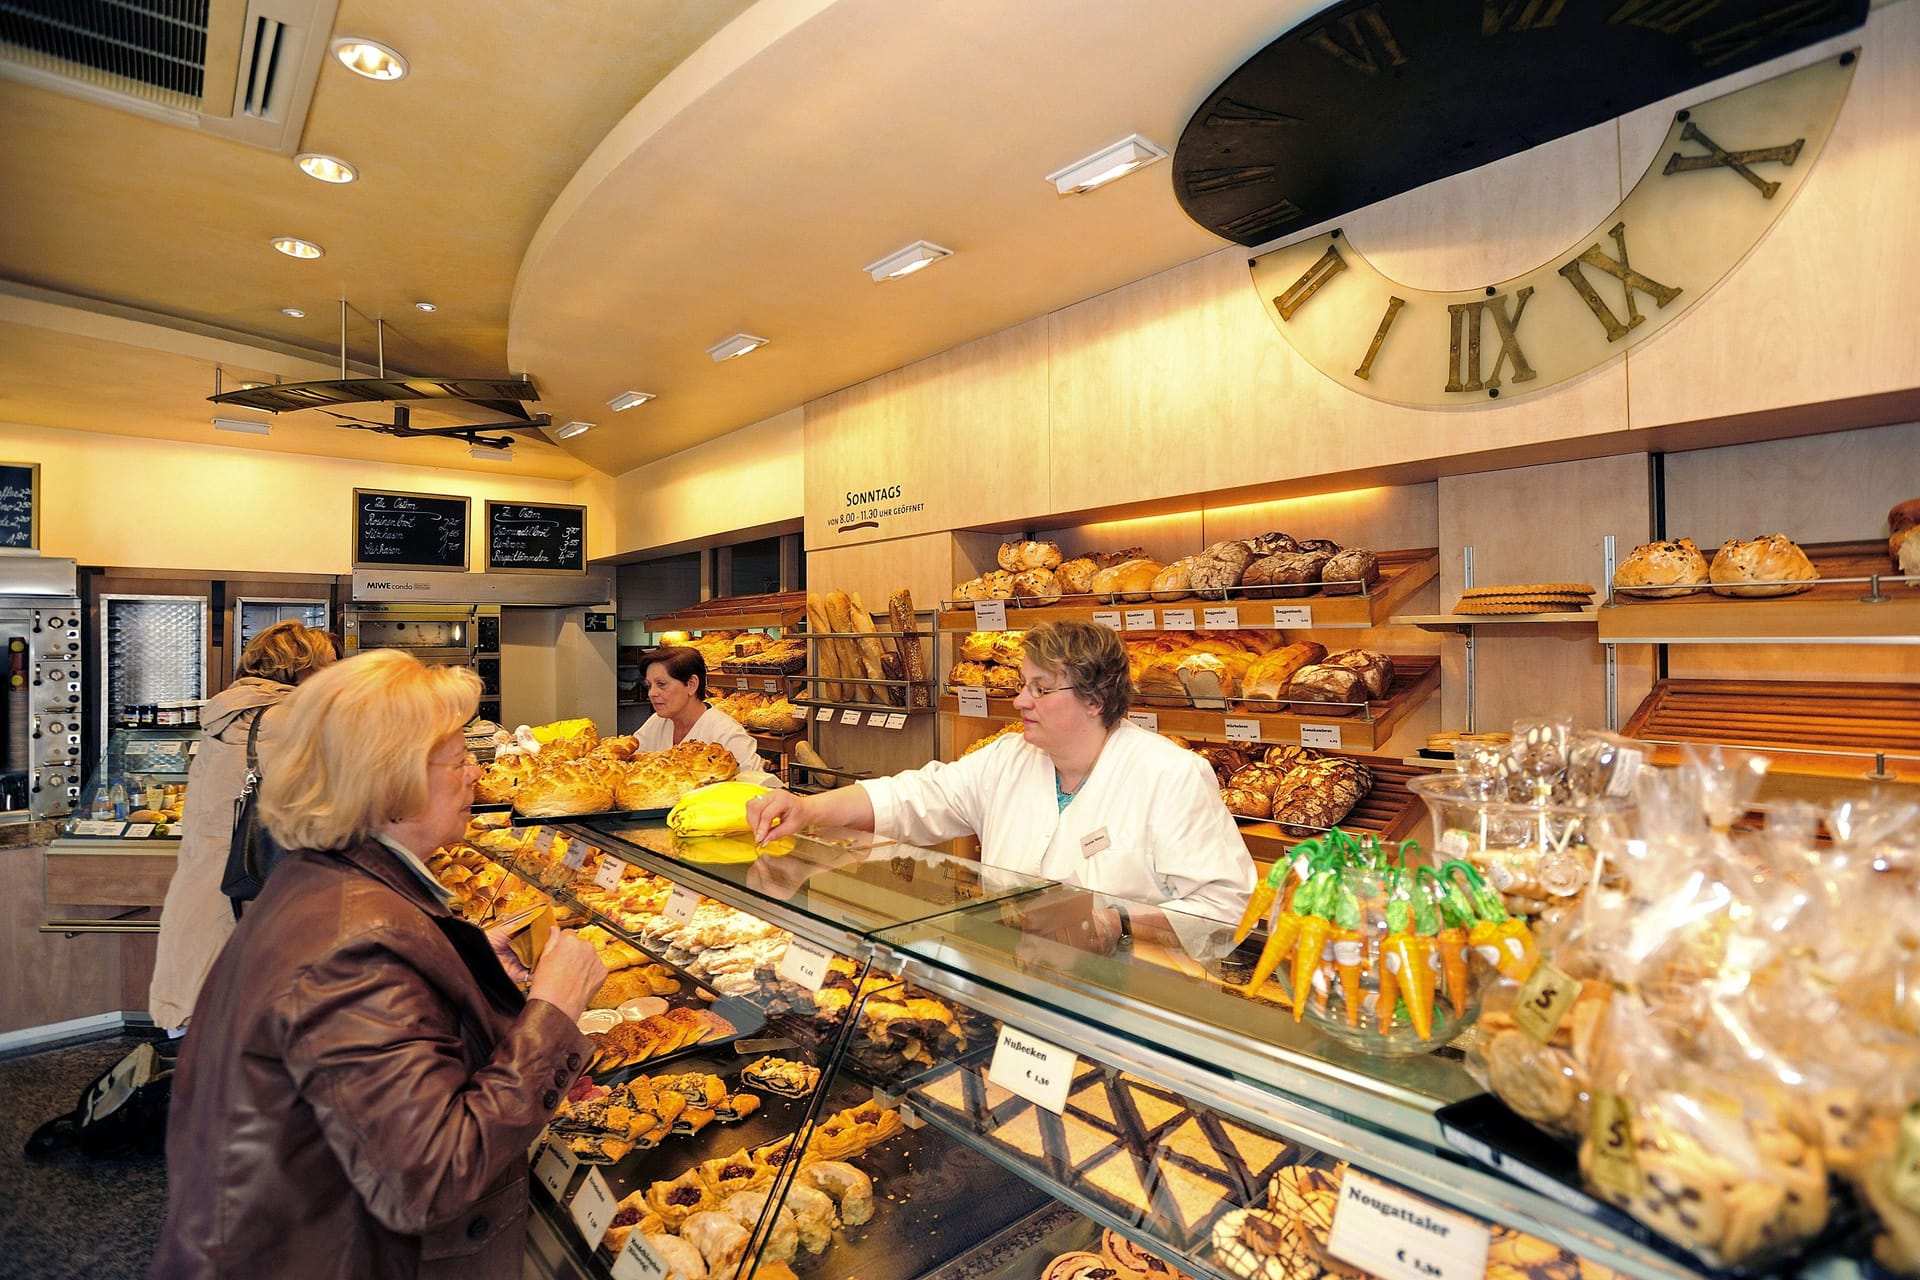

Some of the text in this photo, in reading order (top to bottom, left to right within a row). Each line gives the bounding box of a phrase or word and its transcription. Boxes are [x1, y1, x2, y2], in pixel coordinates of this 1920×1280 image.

[839, 512, 855, 524] 8.00
[860, 508, 878, 520] 11.30
[367, 582, 391, 590] MIWE
[1003, 1036, 1048, 1062] Nußecken
[1026, 1070, 1032, 1079] €
[1348, 1186, 1451, 1238] Nougattaler
